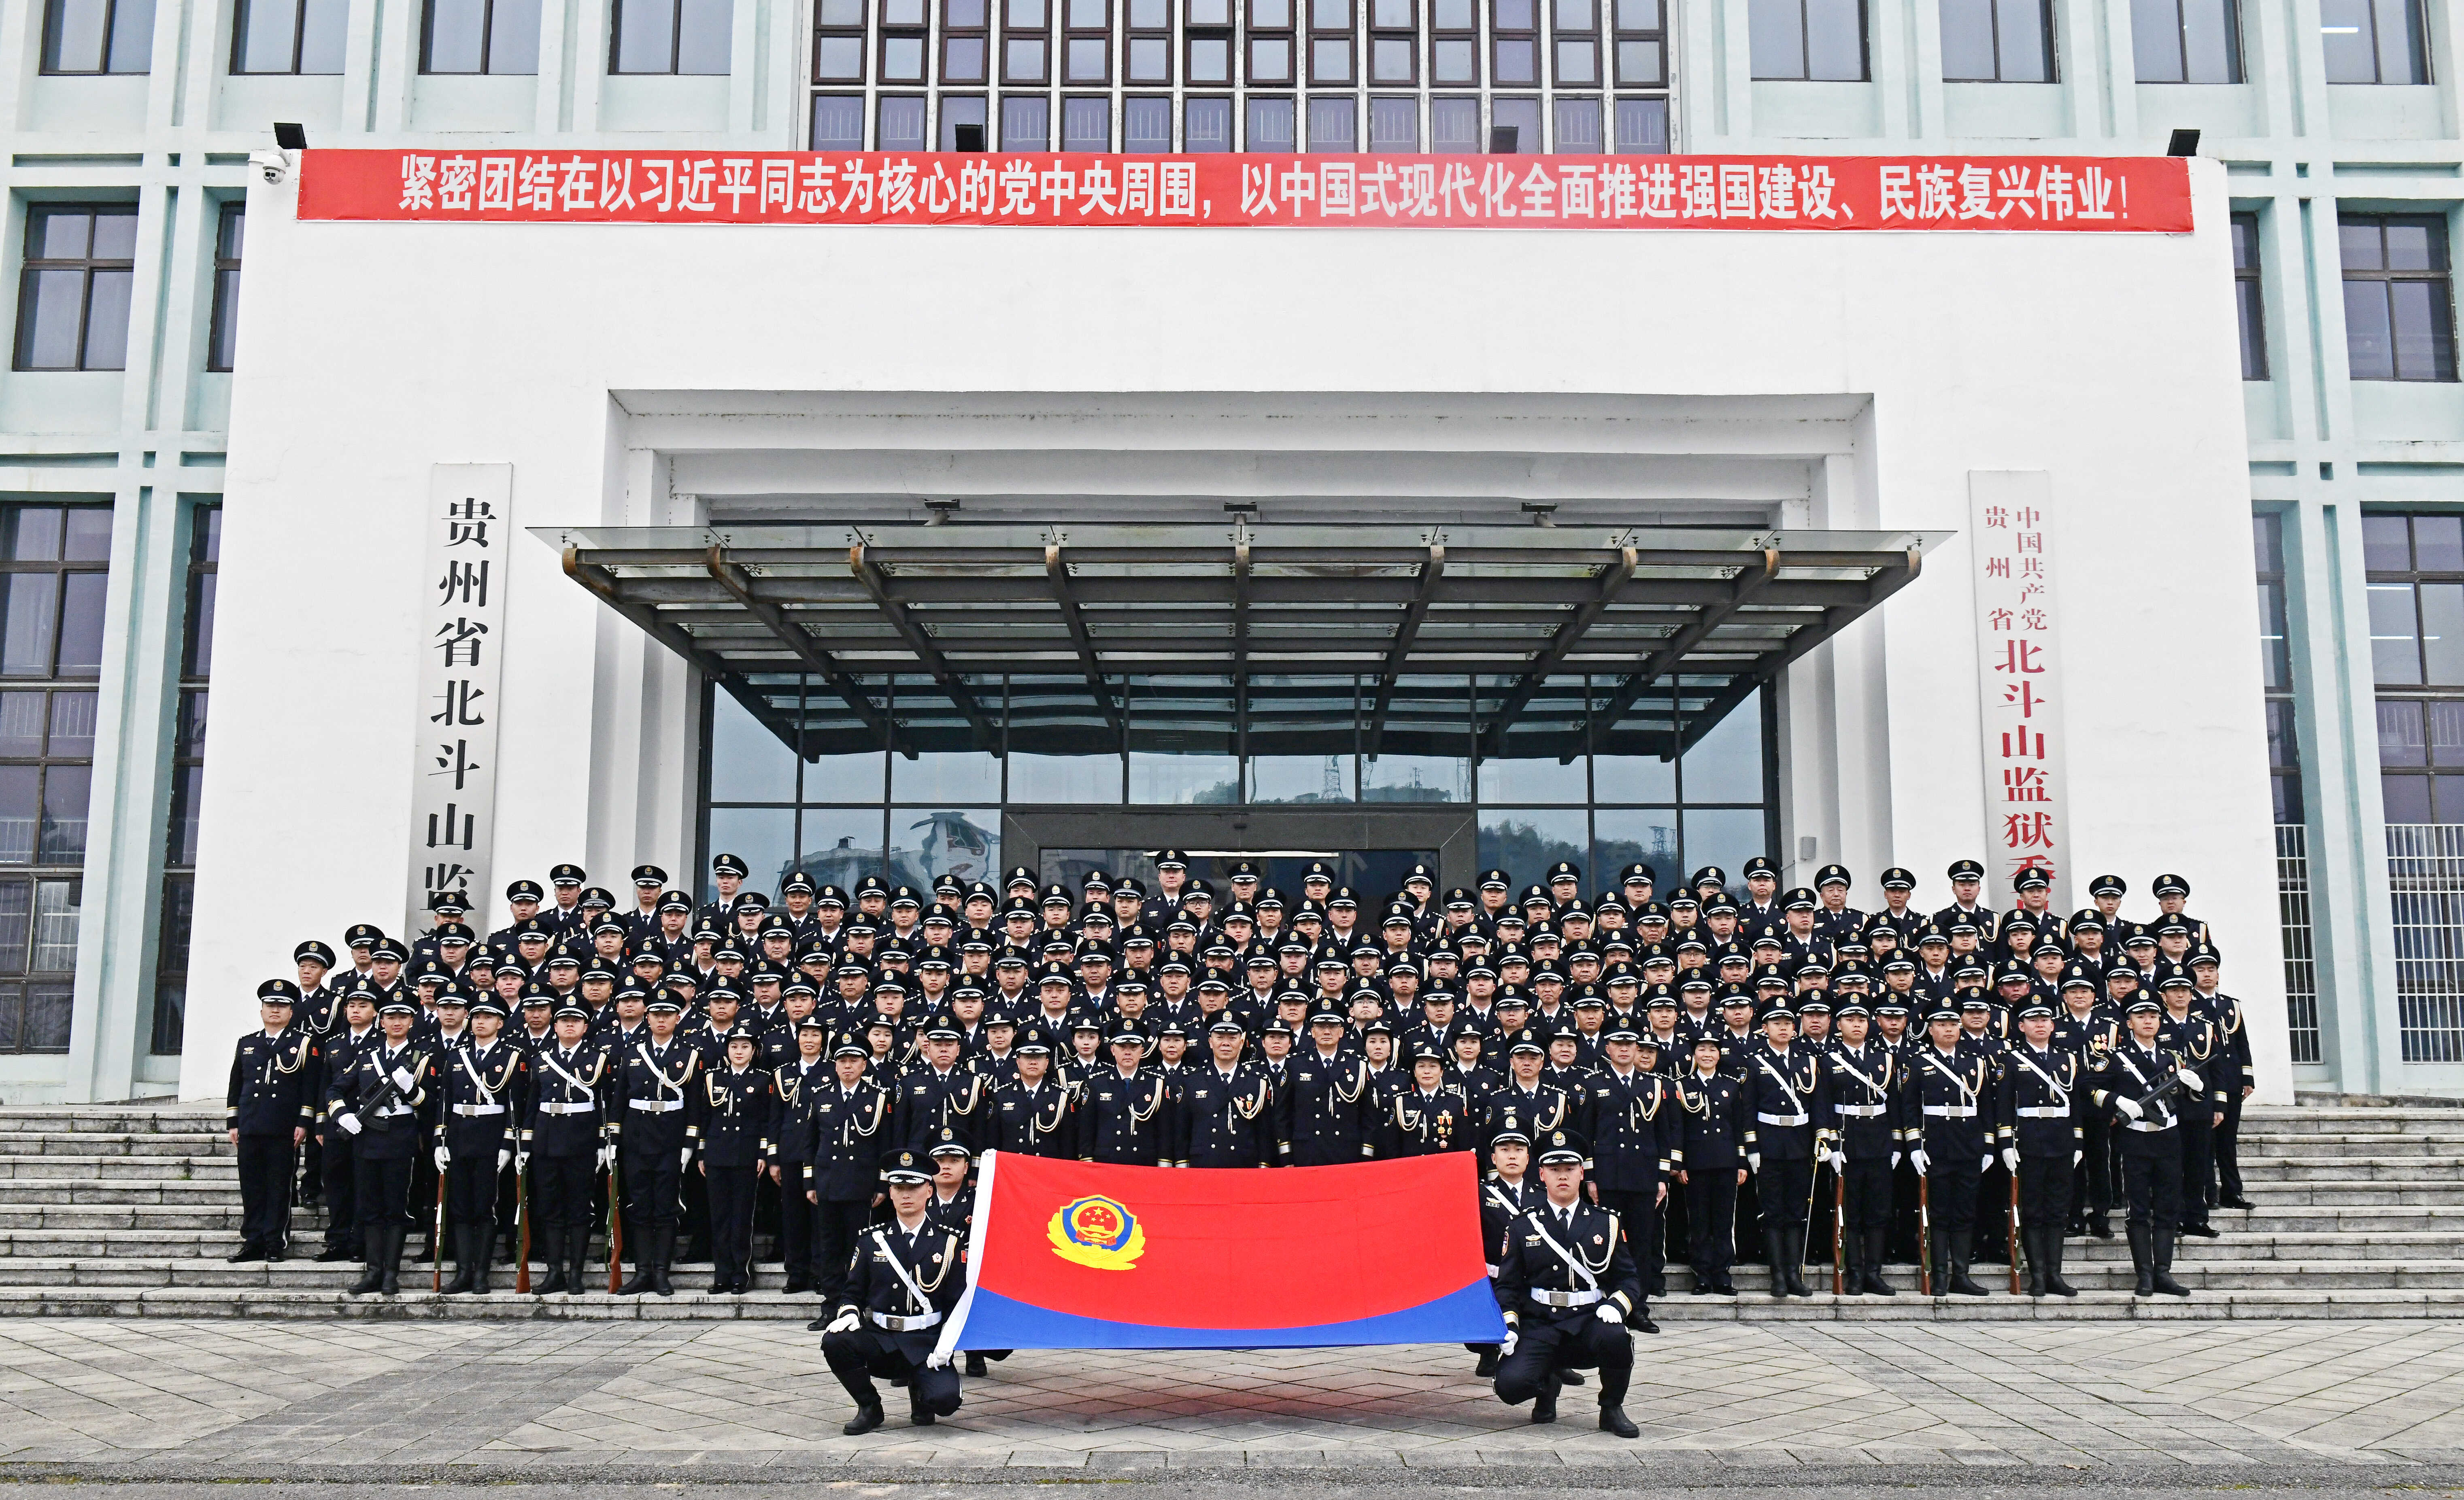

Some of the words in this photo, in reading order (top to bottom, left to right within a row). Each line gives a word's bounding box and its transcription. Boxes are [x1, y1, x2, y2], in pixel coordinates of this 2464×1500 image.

[1982, 506, 2013, 631] 贵州省
[2017, 506, 2048, 631] 中国共产党
[419, 497, 497, 936] 贵州省北斗山监
